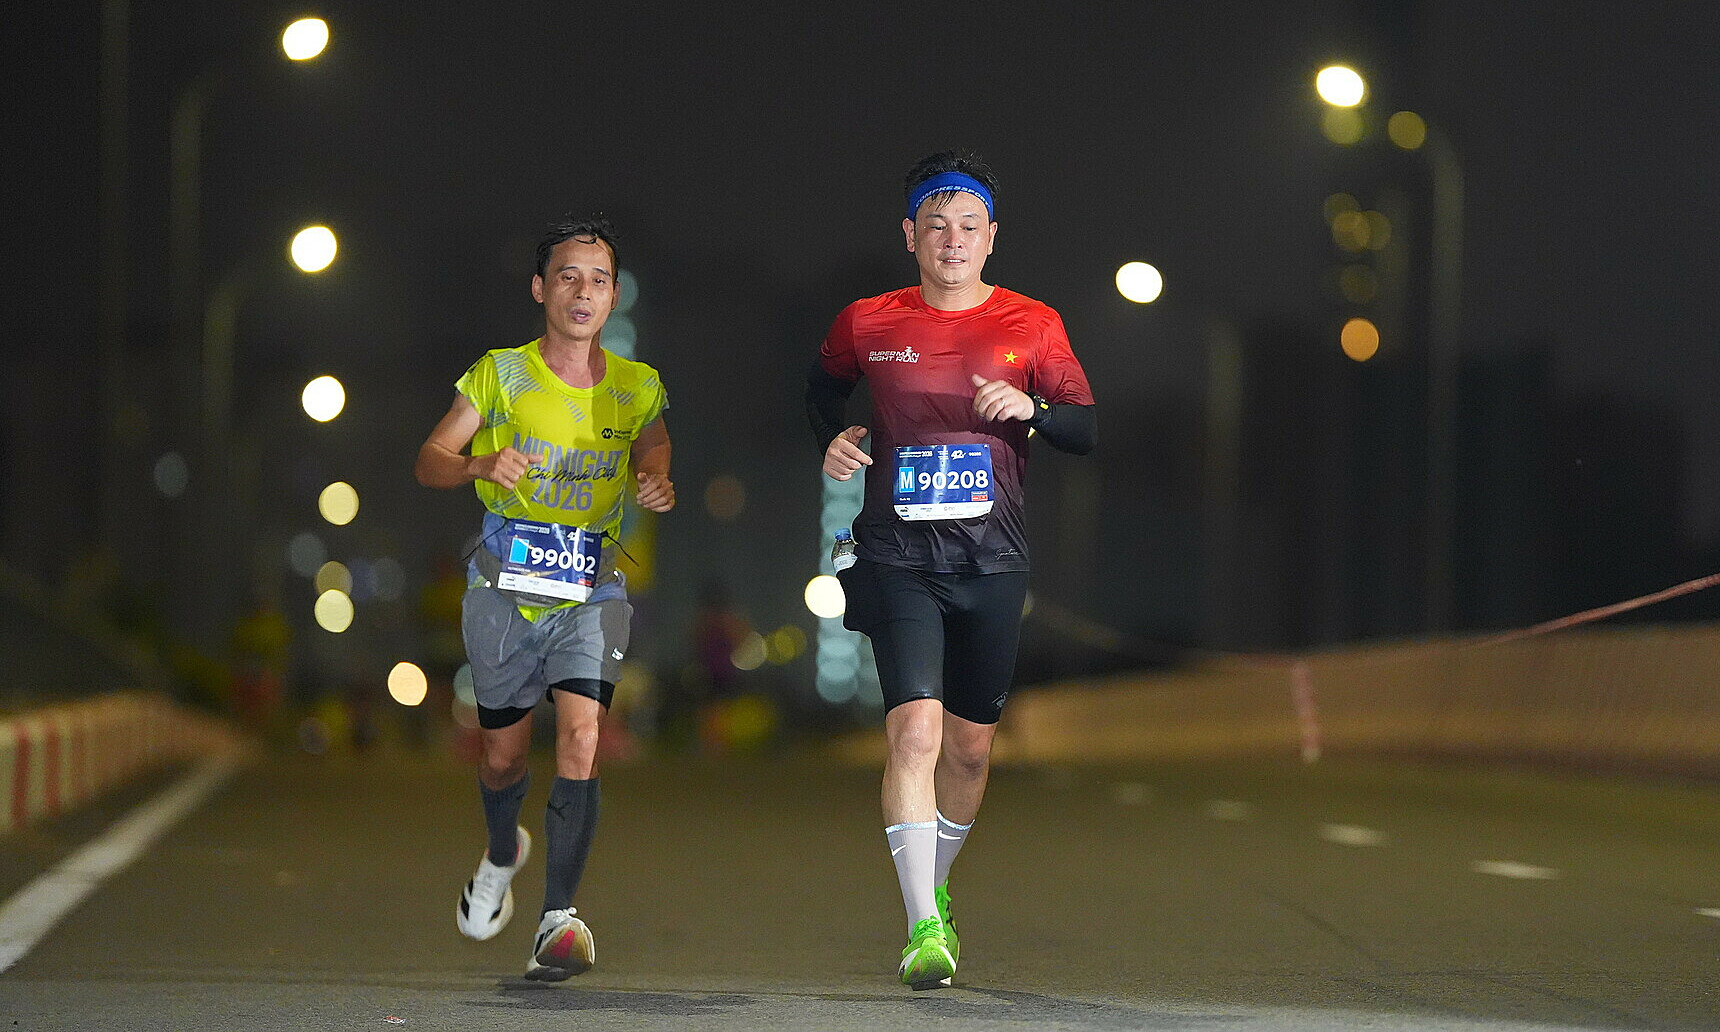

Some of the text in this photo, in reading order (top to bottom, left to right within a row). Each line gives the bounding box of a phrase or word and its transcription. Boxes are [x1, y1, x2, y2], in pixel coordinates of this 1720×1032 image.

[895, 355, 919, 363] RUN
[512, 432, 624, 479] MIDNIGHT
[551, 467, 590, 482] Minh
[900, 470, 914, 490] M
[918, 469, 989, 491] 90208
[530, 477, 594, 511] 2026
[530, 546, 596, 575] 99002
